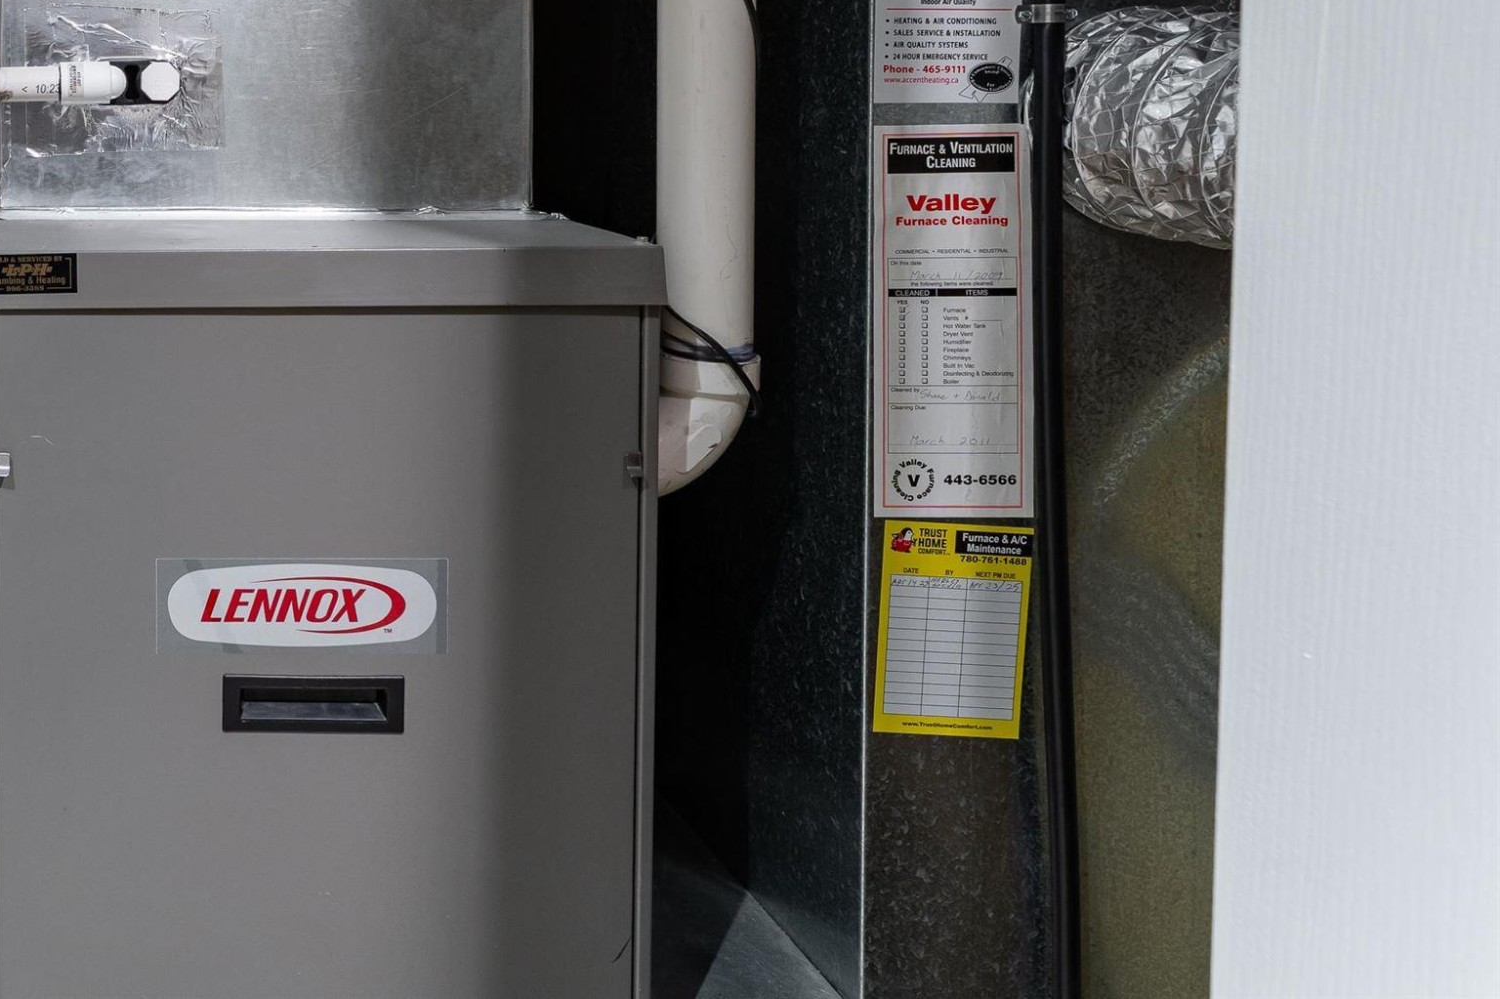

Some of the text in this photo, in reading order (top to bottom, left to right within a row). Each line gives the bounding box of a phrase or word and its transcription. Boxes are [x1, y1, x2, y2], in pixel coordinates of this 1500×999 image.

[893, 17, 997, 25] HEATING & AIR CONDITIONING
[893, 29, 1001, 37] SALES SERVICE & INSTALLATION
[893, 41, 969, 49] AIR QUALITY SYSTEMS
[922, 53, 961, 61] EMERGENCY
[962, 53, 989, 61] SERVICE
[883, 64, 967, 74] Phone 465-9111
[884, 76, 959, 85] www.accentheating.ca
[889, 141, 1014, 156] FURNACE & VENTILATION
[925, 155, 977, 169] CLEANING
[906, 193, 997, 215] Valley
[895, 215, 1009, 228] Furnace Cleaning
[27, 276, 34, 284] &
[36, 275, 66, 286] Heating
[894, 289, 931, 297] CLEANED
[965, 288, 989, 296] ITEMS
[909, 434, 945, 446] March
[898, 458, 928, 469] Valley
[907, 473, 921, 487] V
[916, 468, 935, 500] Furnace
[943, 473, 1018, 486] 443-6566
[891, 469, 914, 502] Cleaning
[918, 527, 948, 538] TRUST
[918, 537, 947, 549] HOME
[961, 532, 1028, 545] Furnace & A/C
[917, 547, 947, 556] COMFORT
[966, 543, 1022, 556] Maintenance
[960, 554, 1028, 566] 780-761-1488
[903, 567, 920, 575] DATE
[992, 571, 1002, 579] PM
[1003, 572, 1016, 580] DUE
[200, 588, 367, 623] LENNOX
[901, 721, 993, 731] www.TrustHomeComfort.com
